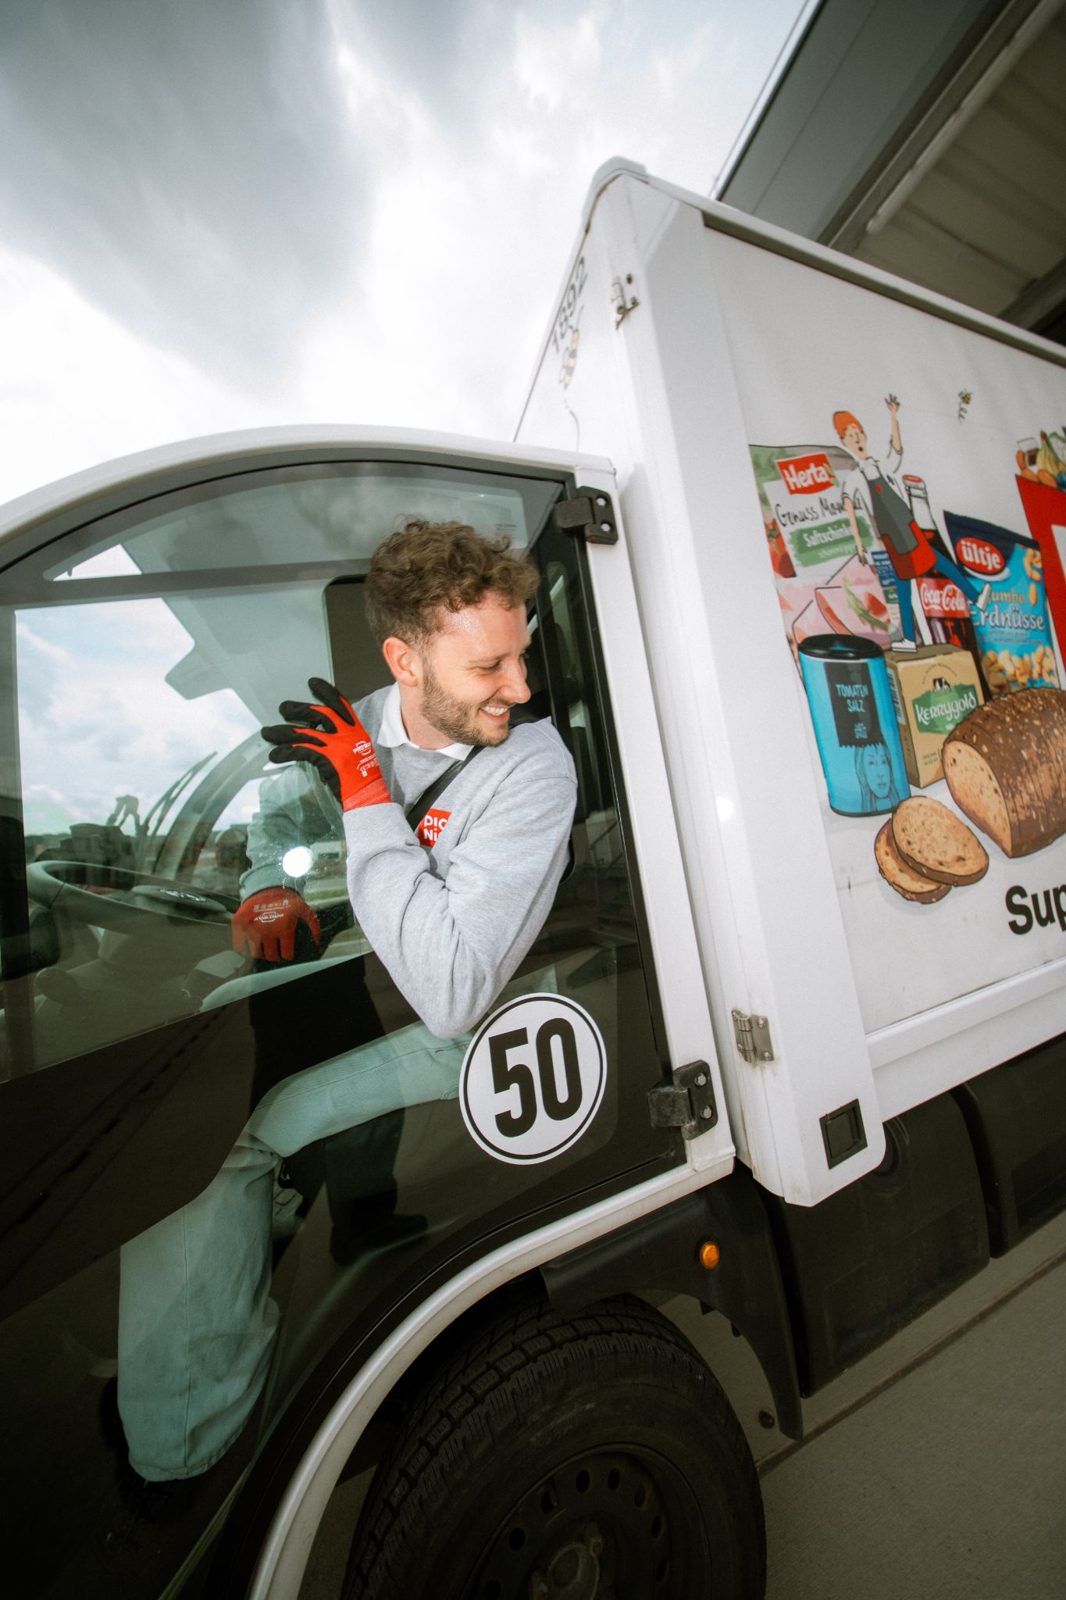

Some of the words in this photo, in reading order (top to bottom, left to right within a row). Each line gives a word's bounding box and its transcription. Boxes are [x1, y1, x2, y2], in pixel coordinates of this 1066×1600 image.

[782, 464, 830, 490] Herta
[960, 539, 1001, 570] ültje
[424, 827, 441, 841] Ni
[489, 1018, 583, 1138] 50
